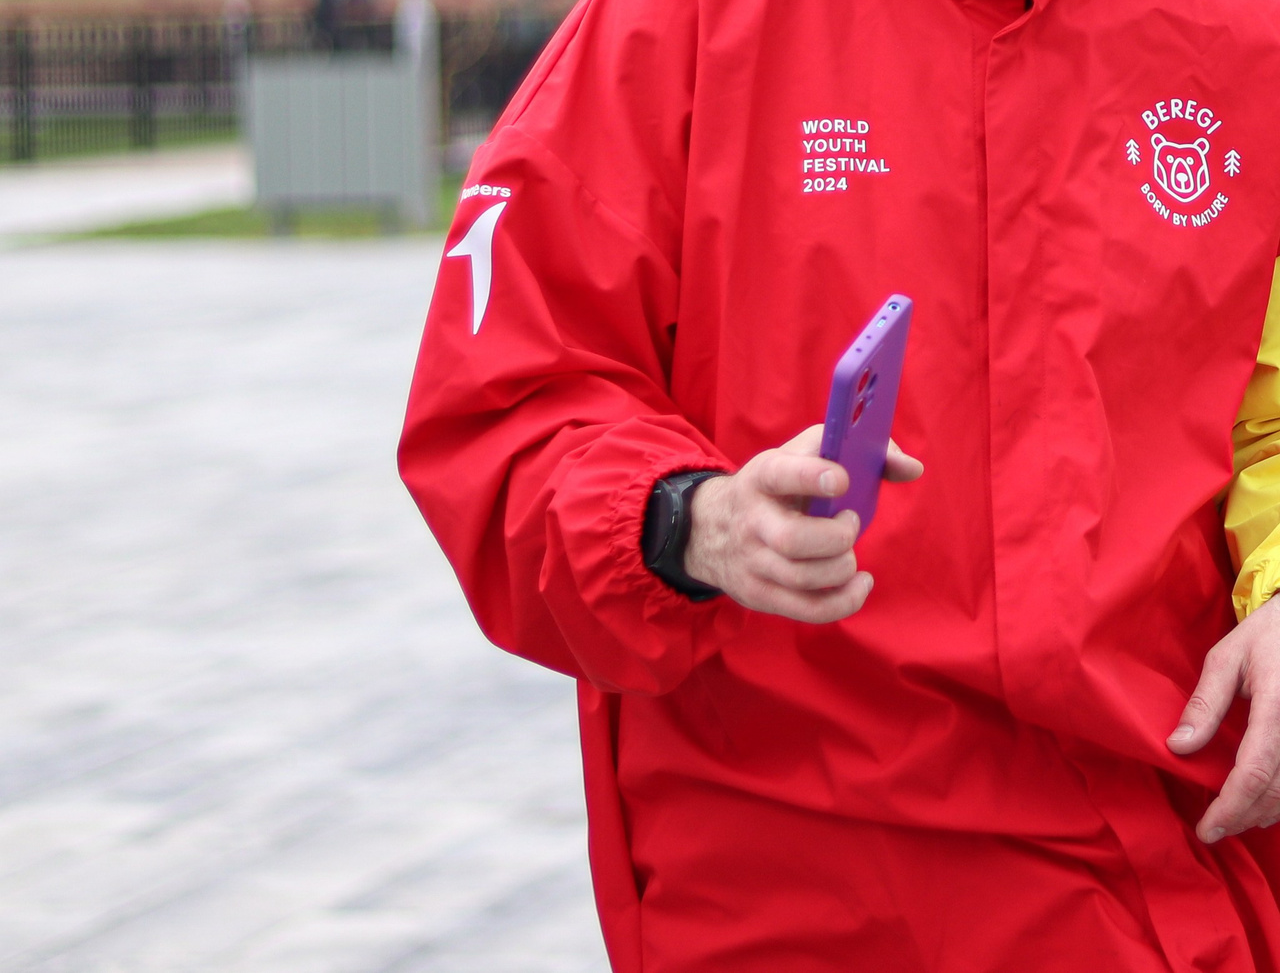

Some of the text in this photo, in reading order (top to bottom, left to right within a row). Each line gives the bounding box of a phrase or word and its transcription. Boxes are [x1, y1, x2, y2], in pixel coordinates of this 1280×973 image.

[1141, 98, 1222, 135] BEREGI
[802, 118, 870, 134] WORLD
[802, 138, 866, 153] YOUTH
[803, 157, 890, 173] FESTIVAL
[803, 177, 848, 193] 2024
[1140, 183, 1229, 227] BORN BY NATURE
